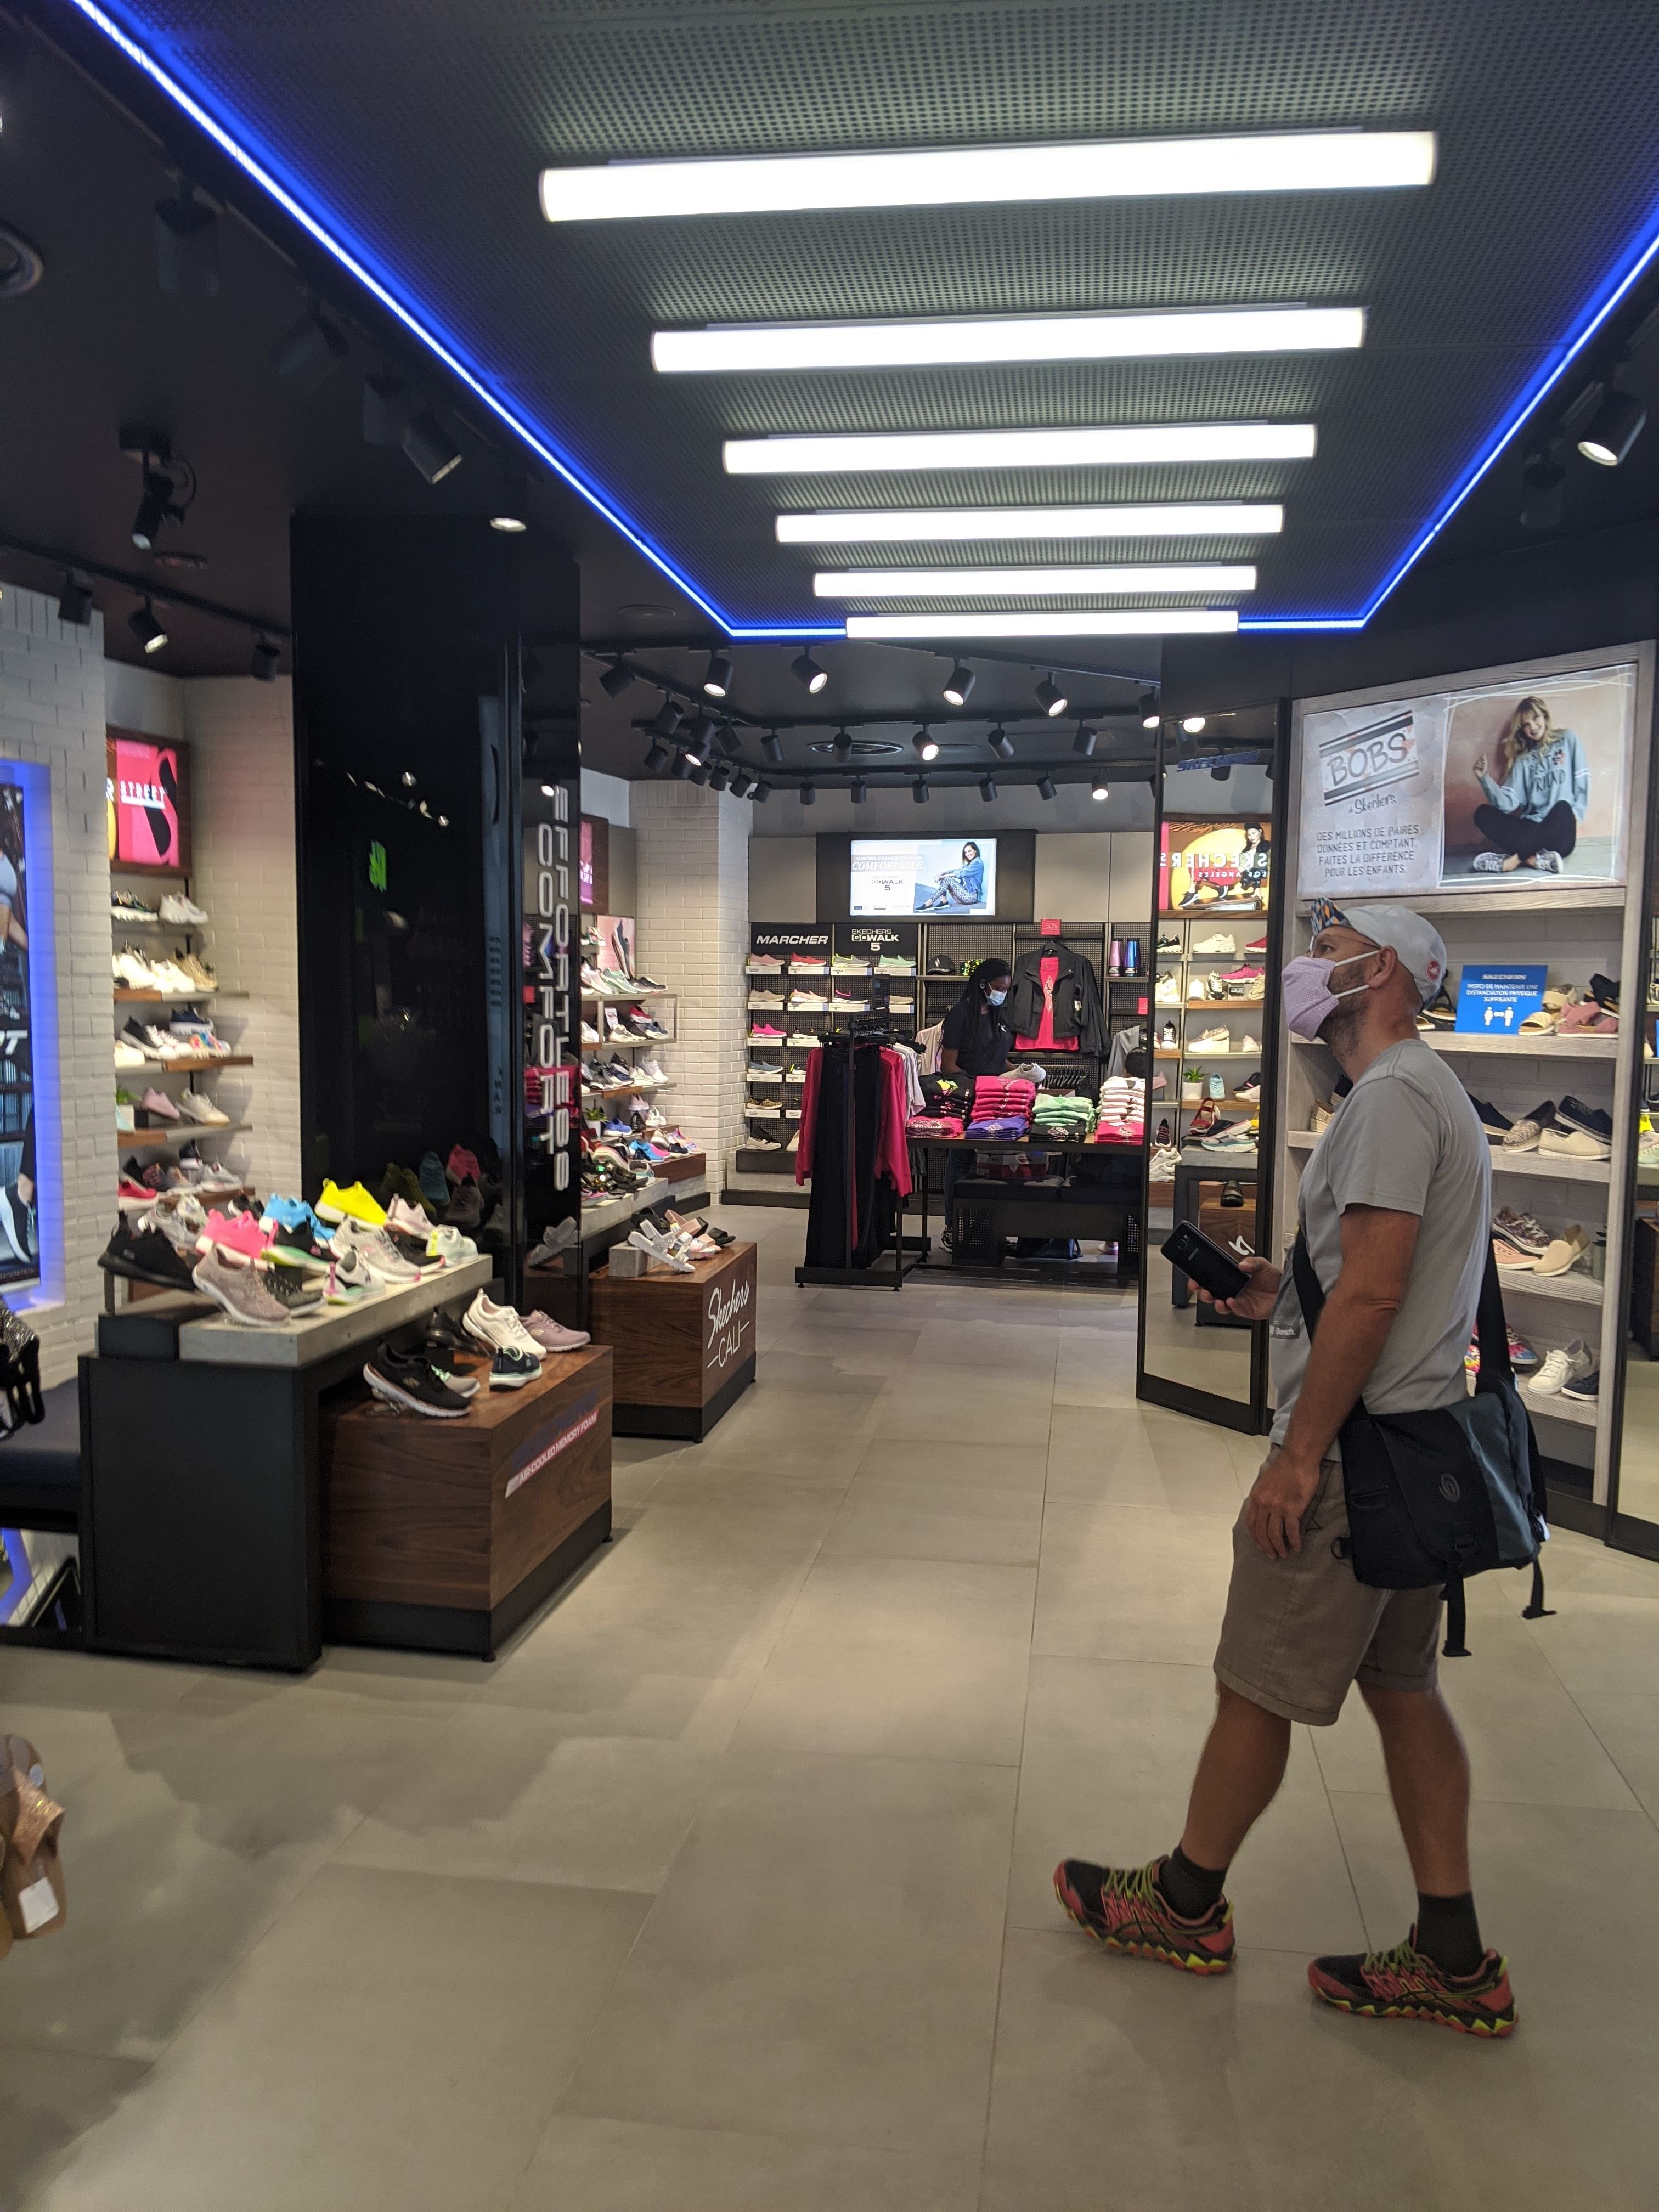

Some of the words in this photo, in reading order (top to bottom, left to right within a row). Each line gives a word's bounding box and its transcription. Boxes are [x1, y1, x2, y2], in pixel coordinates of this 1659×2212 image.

[1327, 732, 1408, 786] BOBS
[1317, 831, 1333, 842] DES
[1335, 828, 1372, 840] MILLIONS
[1374, 827, 1386, 837] DE
[1387, 824, 1419, 837] PAIRES
[1317, 840, 1354, 854] DONNÉES
[1356, 840, 1368, 851] ET
[1318, 855, 1348, 866] FAITES
[1350, 854, 1361, 864] LA
[1324, 867, 1346, 878] POUR
[1347, 866, 1364, 876] LES
[756, 935, 828, 944] MARCHER
[870, 942, 881, 951] 5
[538, 822, 554, 1155] COMFORT
[552, 783, 569, 1192] EFFORTLESS
[707, 1279, 750, 1350] Skechers
[555, 1425, 581, 1452] MEMORY
[580, 1413, 597, 1434] FOAM
